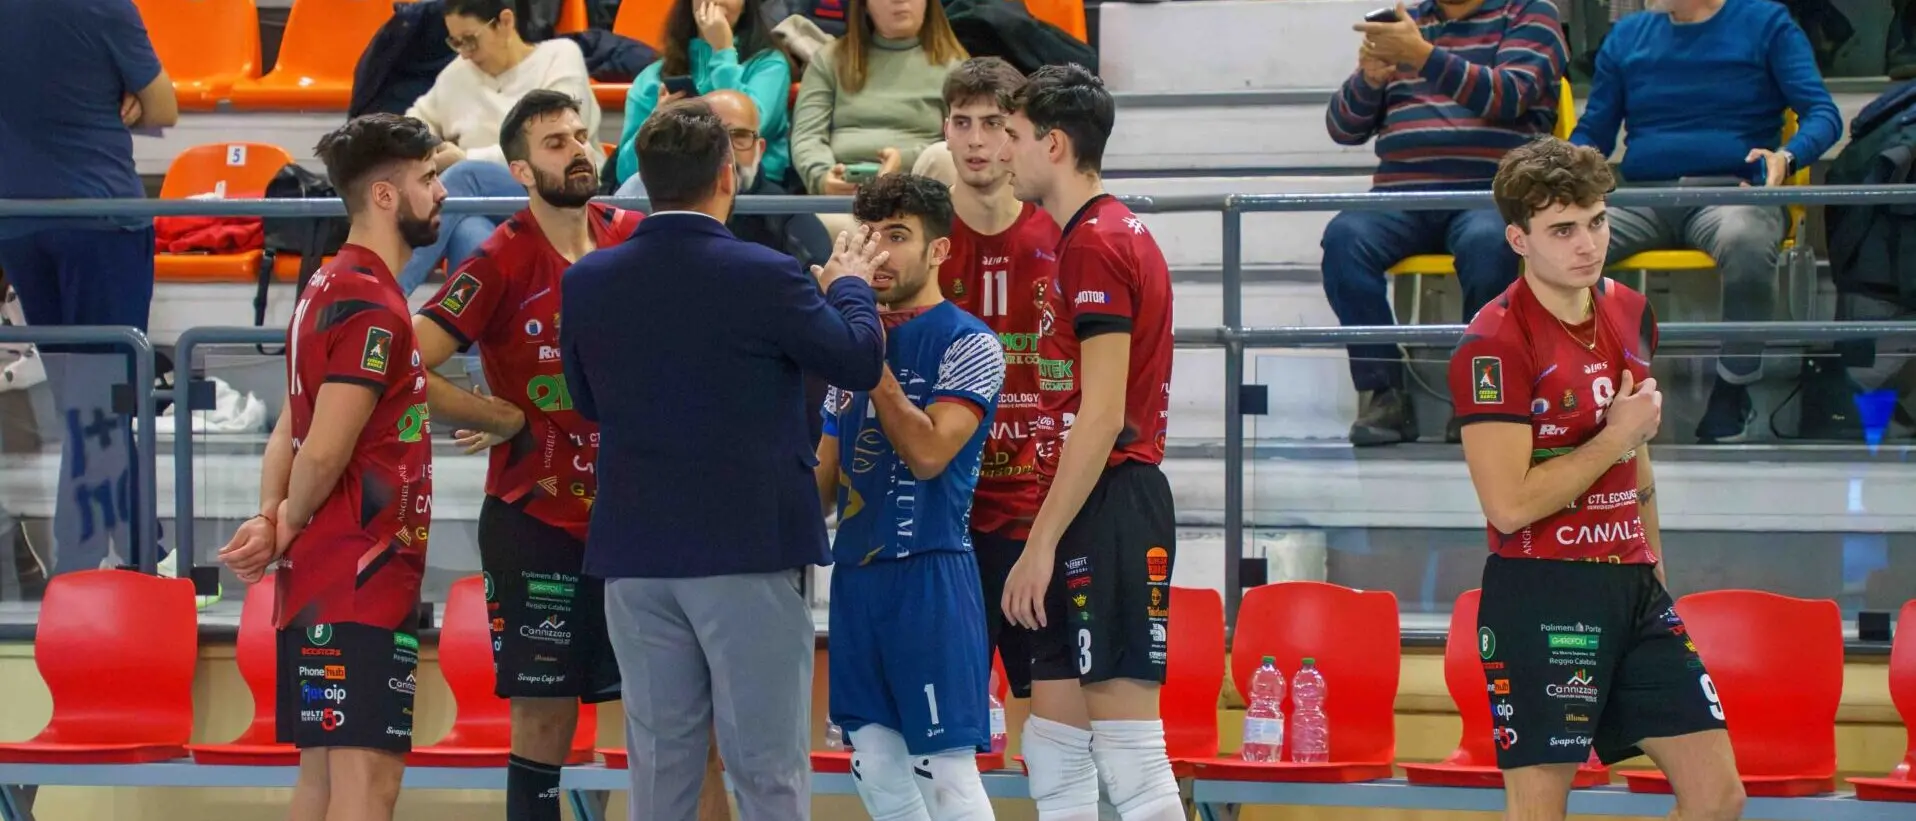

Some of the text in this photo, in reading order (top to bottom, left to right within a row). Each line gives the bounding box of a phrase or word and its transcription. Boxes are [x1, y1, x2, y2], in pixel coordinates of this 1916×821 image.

[231, 147, 241, 164] 5
[983, 270, 1007, 316] 11
[1078, 628, 1092, 675] 3
[1482, 633, 1489, 652] B
[924, 683, 940, 725] 1
[1546, 683, 1598, 697] Cannizzaro
[1700, 673, 1725, 720] 9
